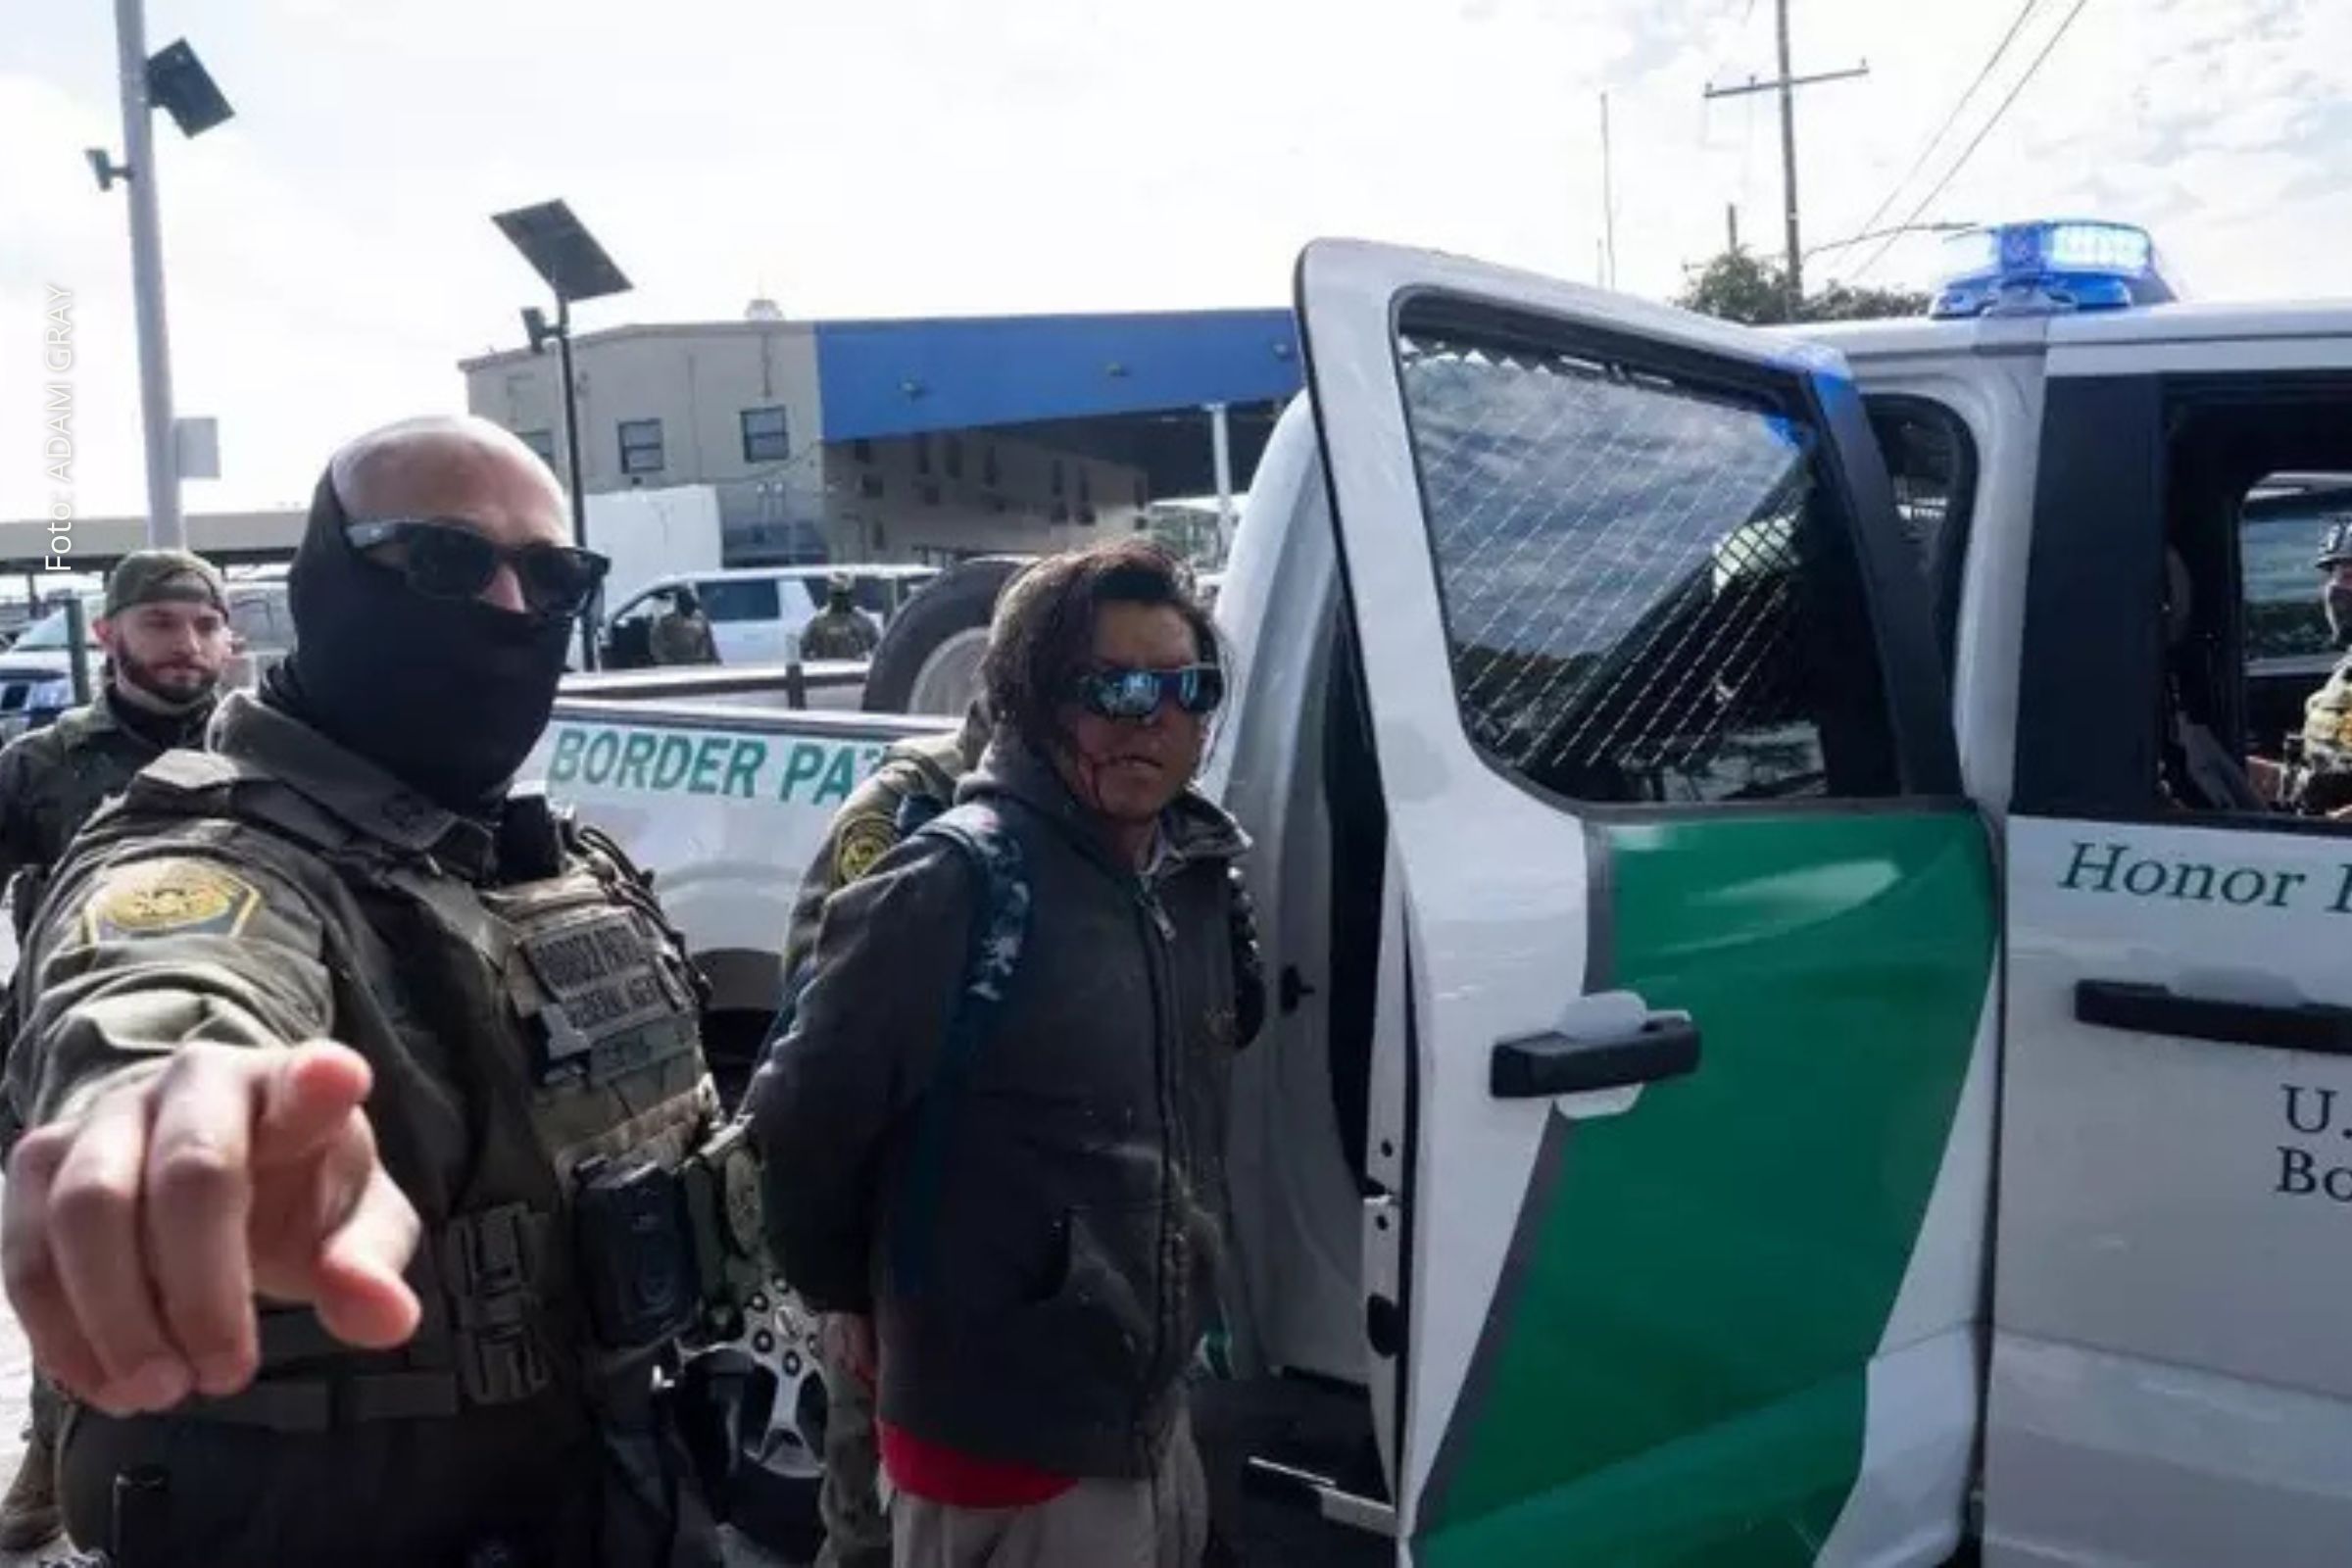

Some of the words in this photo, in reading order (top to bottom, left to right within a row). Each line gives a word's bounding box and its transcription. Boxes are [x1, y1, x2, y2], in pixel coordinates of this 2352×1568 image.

[549, 730, 767, 799] BORDER
[2058, 841, 2306, 907] Honor
[2276, 1146, 2352, 1202] Bo
